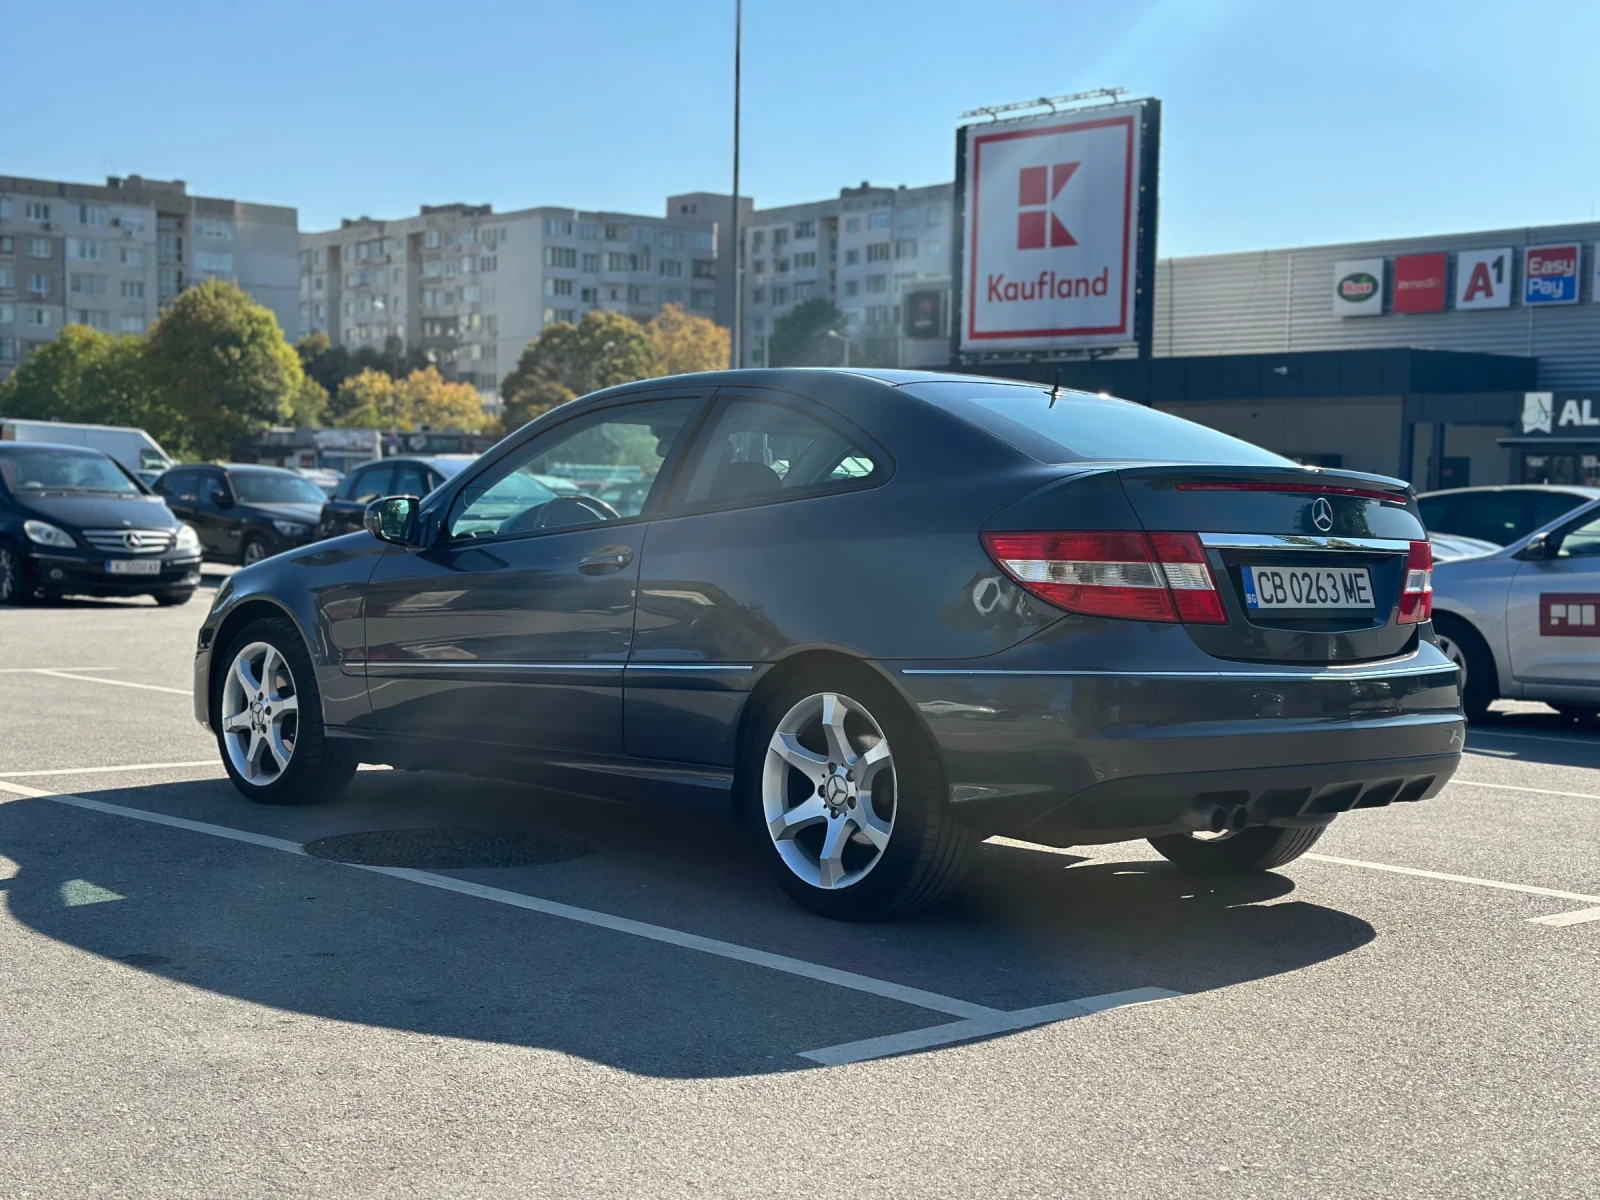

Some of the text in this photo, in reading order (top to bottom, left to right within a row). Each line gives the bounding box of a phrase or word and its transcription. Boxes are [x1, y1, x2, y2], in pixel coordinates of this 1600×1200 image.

[1463, 255, 1504, 302] A1
[1529, 257, 1575, 277] Easy
[987, 267, 1109, 303] Kaufland
[1528, 278, 1563, 298] Pay
[1246, 594, 1257, 604] BG
[1257, 571, 1371, 604] CB 0263 ME
